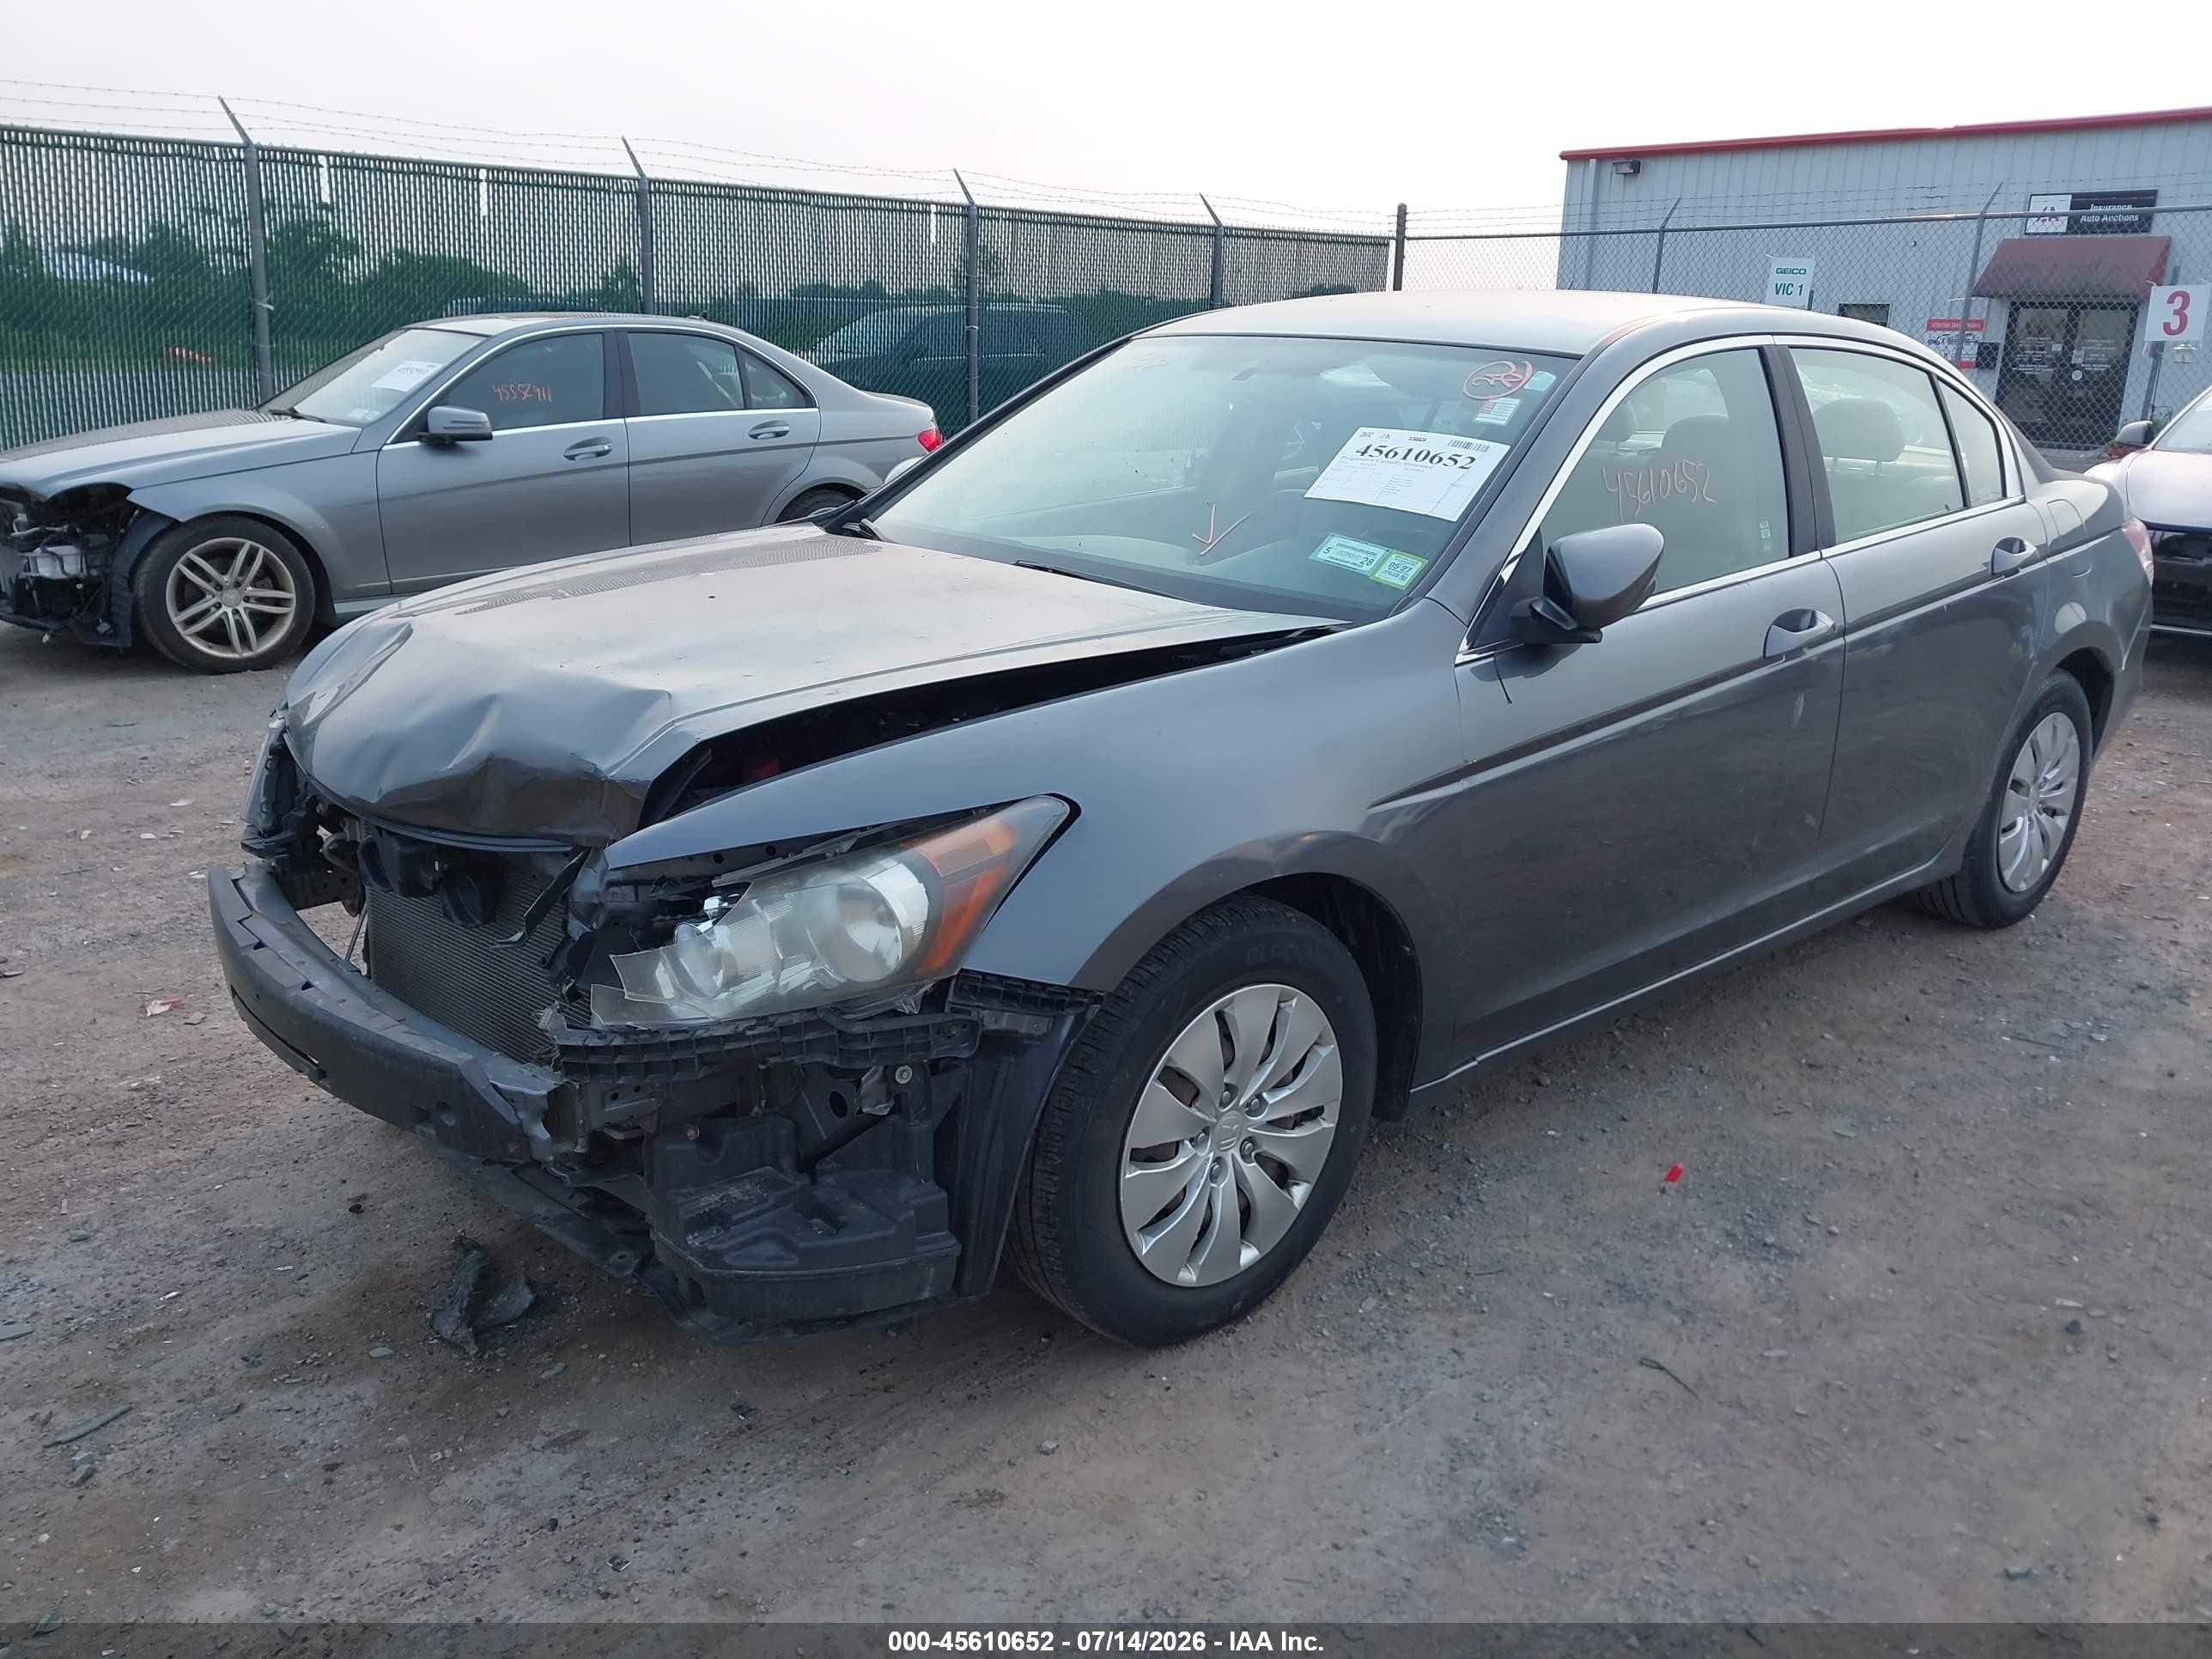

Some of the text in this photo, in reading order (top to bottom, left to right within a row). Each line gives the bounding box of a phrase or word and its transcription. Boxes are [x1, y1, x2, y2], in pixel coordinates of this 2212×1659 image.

[2080, 213, 2139, 222] Auto Auctions
[1775, 283, 1804, 295] VIC 1
[2162, 289, 2191, 336] 3
[1354, 443, 1476, 470] 45610652
[1601, 459, 1717, 522] 45610652
[1360, 556, 1375, 567] 28
